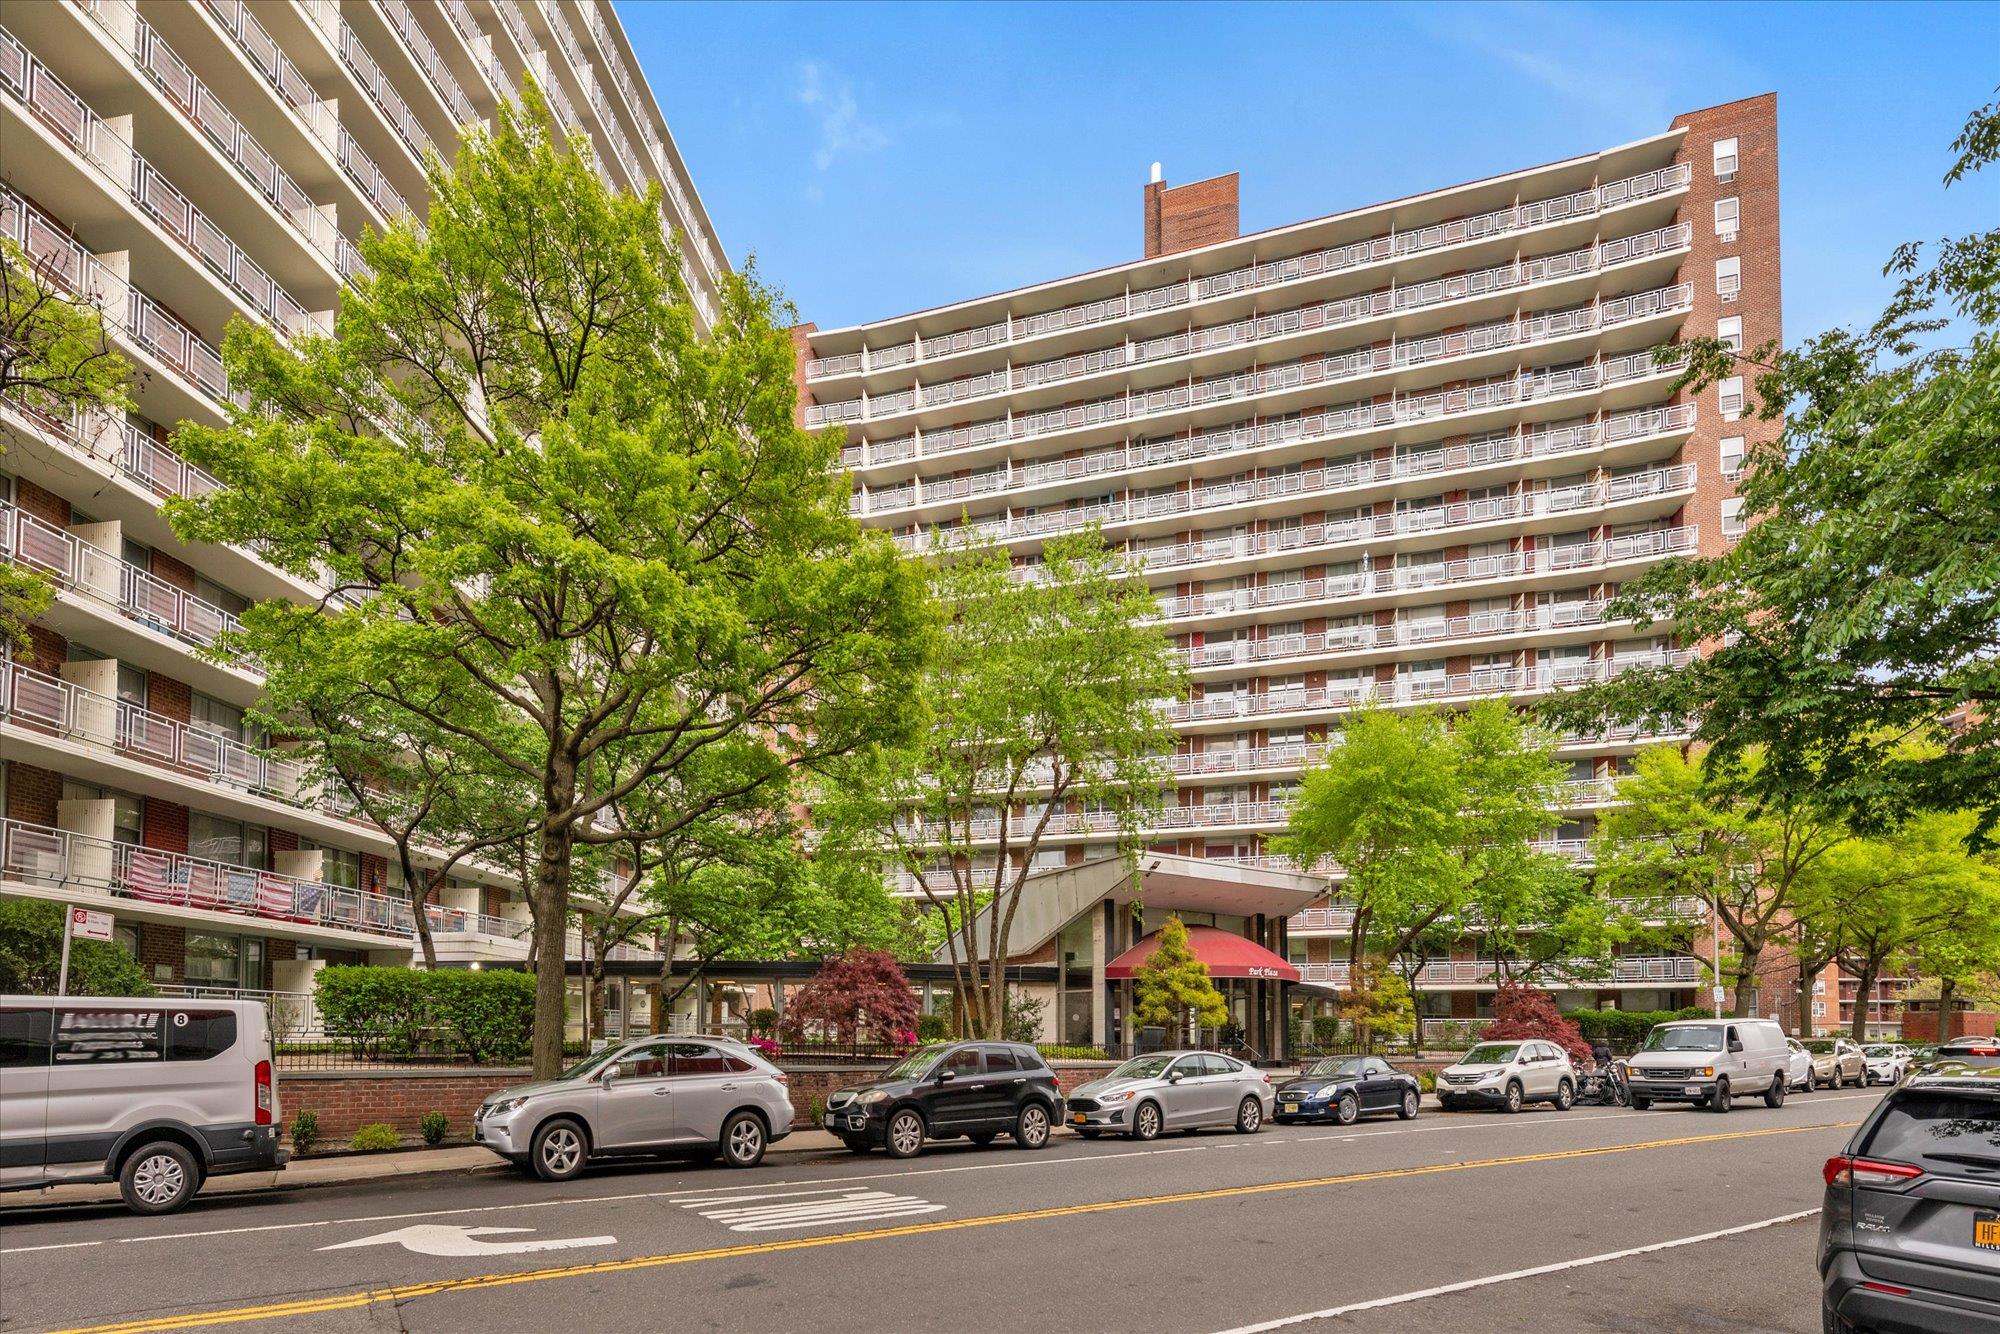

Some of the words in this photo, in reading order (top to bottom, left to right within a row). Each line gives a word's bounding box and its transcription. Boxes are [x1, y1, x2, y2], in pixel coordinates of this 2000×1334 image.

[1249, 967, 1264, 978] Park
[1264, 967, 1279, 977] Plaza
[176, 1014, 186, 1025] 8
